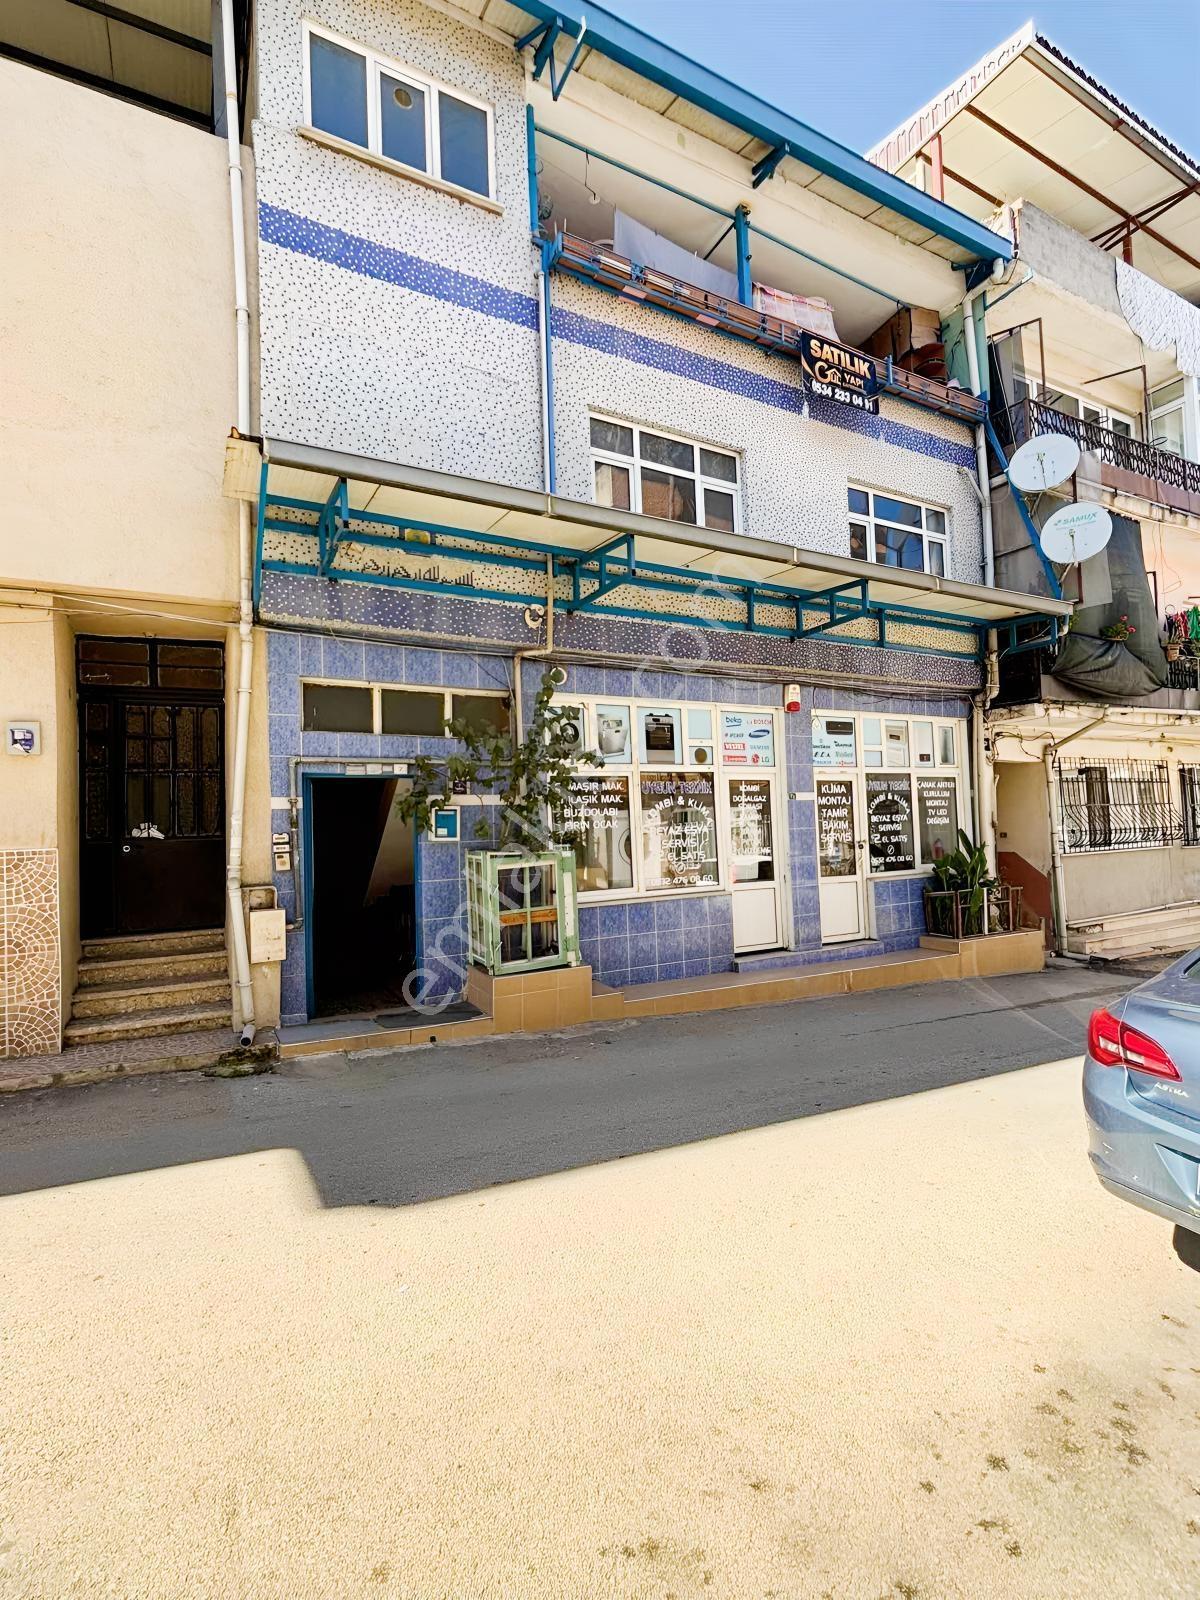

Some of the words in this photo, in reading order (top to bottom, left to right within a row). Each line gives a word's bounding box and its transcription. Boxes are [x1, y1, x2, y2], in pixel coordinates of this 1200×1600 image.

[810, 339, 871, 379] SATILIK
[844, 373, 864, 389] YAPI
[811, 379, 832, 397] 0534
[834, 388, 850, 403] 233
[852, 395, 863, 407] 04
[821, 783, 847, 794] KLİMA
[818, 796, 851, 805] MONTAJ
[563, 808, 618, 818] BUZDOLABI
[821, 806, 848, 817] TAMİR
[593, 820, 618, 829] OCAK
[822, 820, 849, 830] BAKIM
